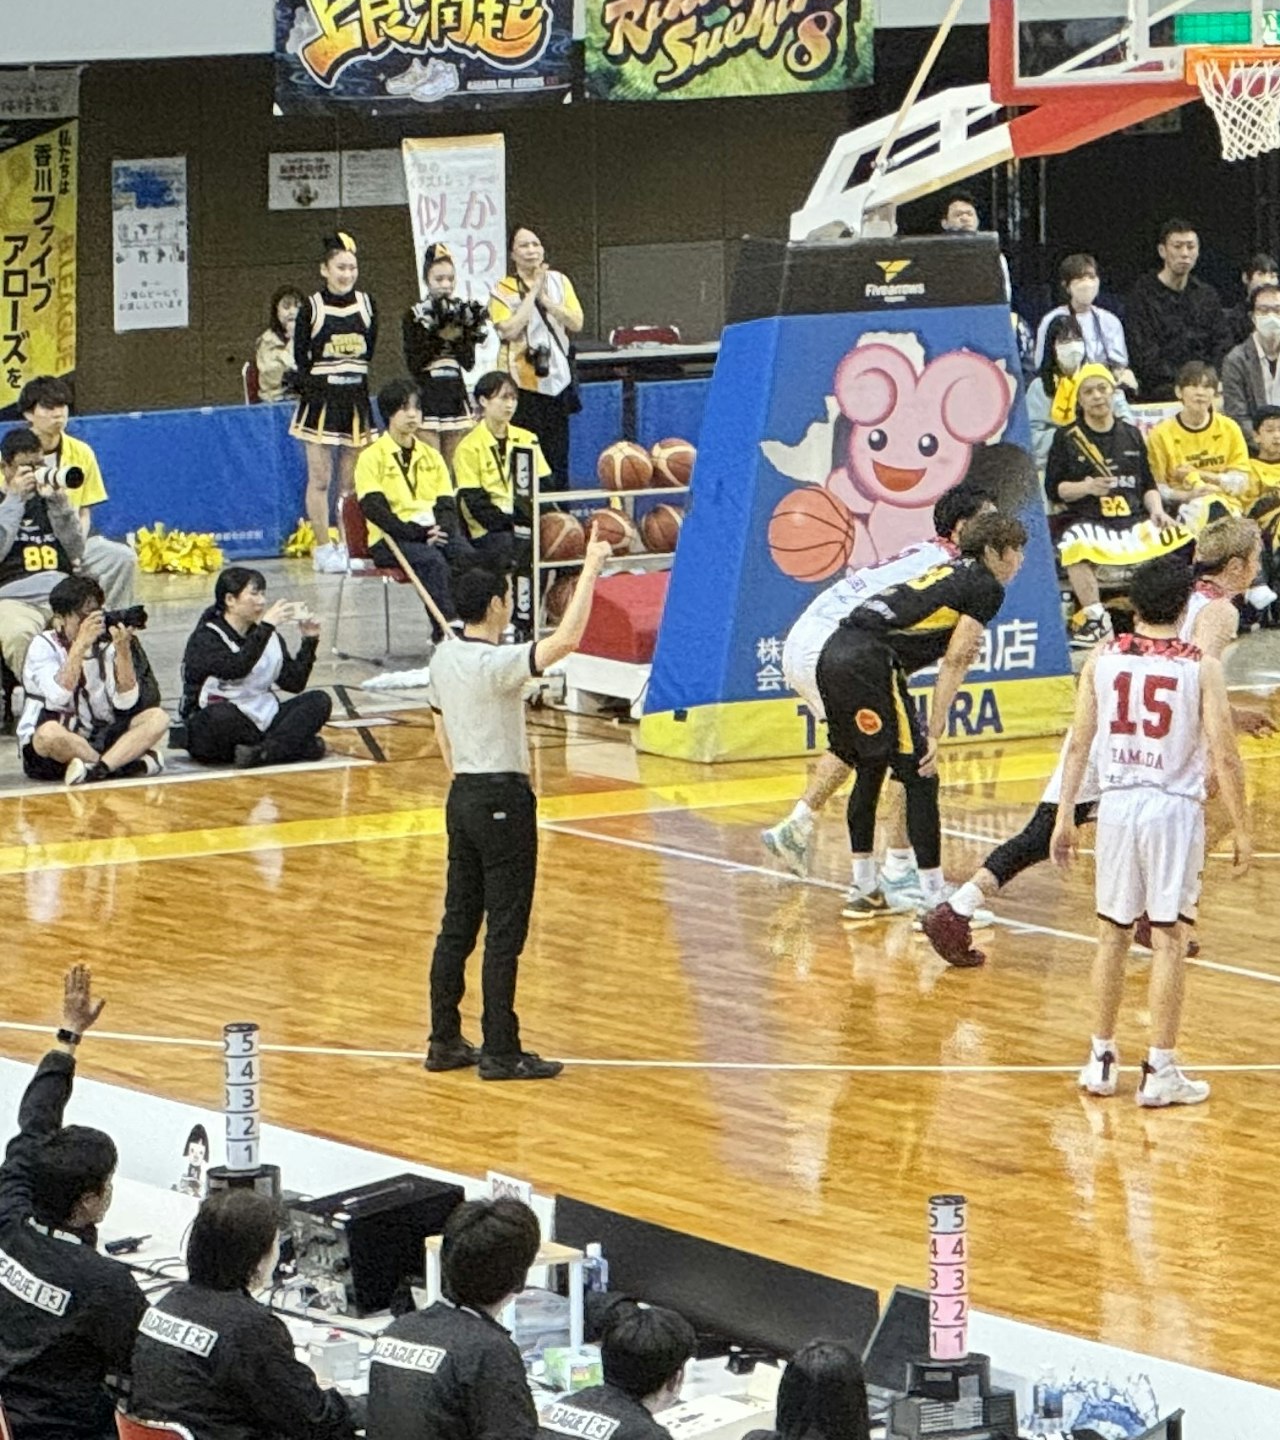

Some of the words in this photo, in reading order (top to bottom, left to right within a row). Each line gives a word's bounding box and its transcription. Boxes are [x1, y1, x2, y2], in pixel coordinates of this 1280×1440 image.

[785, 10, 837, 73] 8
[29, 143, 56, 313] 香川ファイブ
[3, 234, 30, 389] アローズを
[23, 545, 58, 572] 88
[1109, 670, 1179, 740] 15
[241, 1032, 254, 1052] 5
[240, 1060, 255, 1079] 4
[241, 1088, 255, 1108] 3
[243, 1116, 256, 1136] 2
[243, 1145, 253, 1163] 1
[952, 1206, 965, 1228] 5
[951, 1237, 965, 1258] 4
[952, 1268, 965, 1290] 3
[952, 1299, 965, 1321] 2
[953, 1330, 964, 1353] 1
